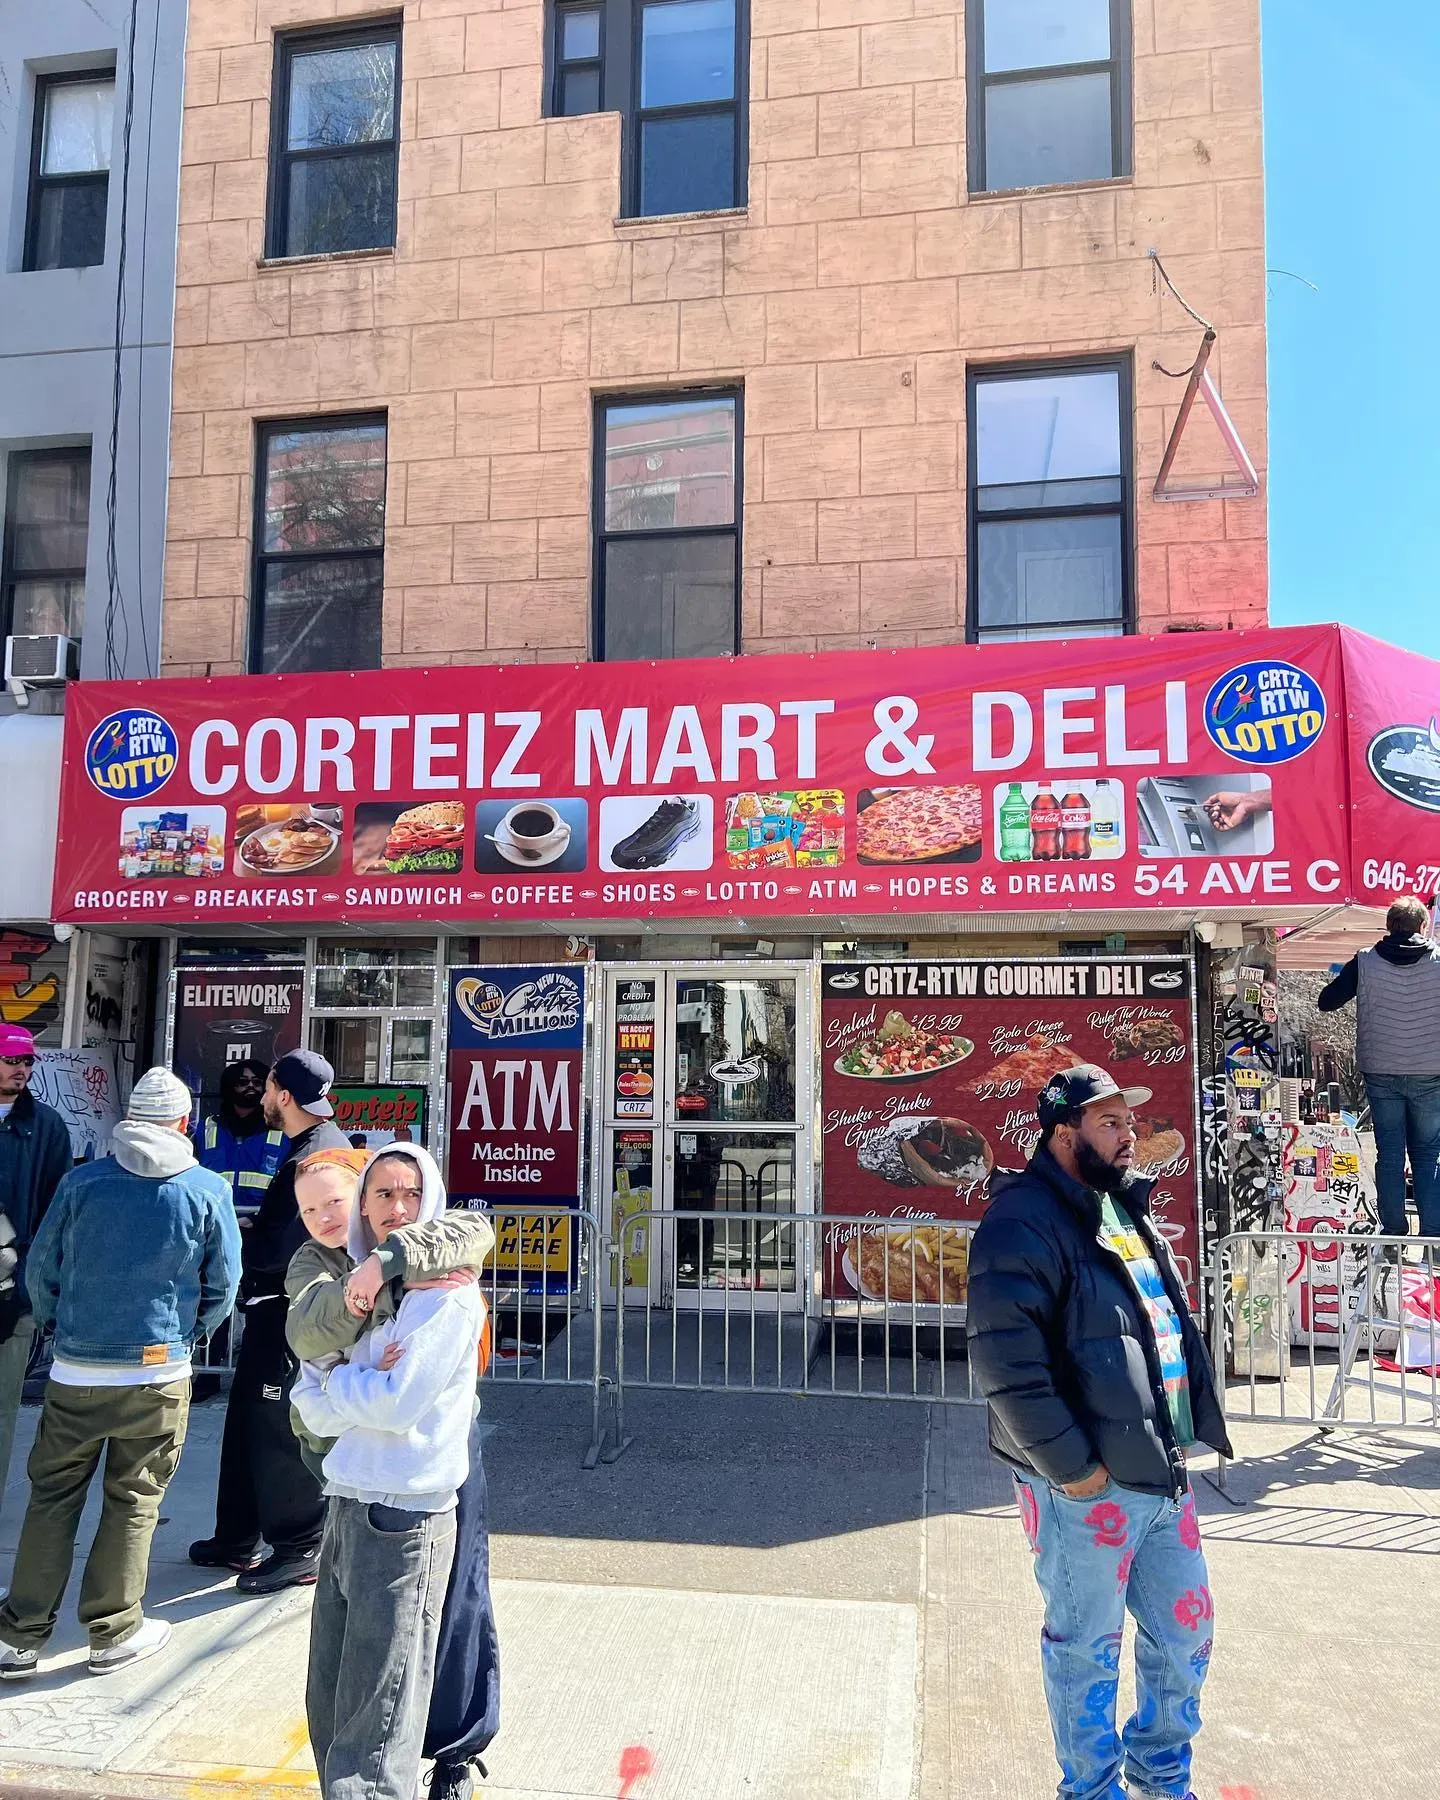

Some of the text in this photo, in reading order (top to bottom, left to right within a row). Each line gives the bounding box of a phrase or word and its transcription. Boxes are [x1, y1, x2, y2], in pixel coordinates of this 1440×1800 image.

[1258, 669, 1302, 690] CRTZ
[1260, 689, 1309, 716] RTW
[128, 717, 162, 736] CRTZ
[189, 681, 1189, 795] CORTEIZ MART & DELI
[1215, 711, 1322, 752] LOTTO
[128, 732, 166, 757] RTW
[93, 753, 174, 790] LOTTO
[1134, 859, 1341, 896] 54 AVE C
[74, 872, 1116, 908] GROCERY BREAKFAST SANDWICH COFFEE SHOES LOTTO ATM HOPES & DREAMS
[536, 973, 579, 992] NEW YORK'S
[865, 965, 1143, 996] CRTZ-RTW GOURMET DELI
[184, 984, 291, 1006] ELITEWORK
[477, 997, 502, 1011] LOTTO
[622, 992, 651, 1000] CREDIT?
[264, 1006, 290, 1014] ENERGY
[1087, 1005, 1174, 1030] Rules The World
[489, 1014, 578, 1039] MILLIONS
[826, 1003, 876, 1048] Salad
[911, 1014, 963, 1031] $13.99
[988, 1020, 1064, 1045] Bolo Cheese
[1103, 1020, 1133, 1039] Cookie
[621, 1033, 650, 1047] RTW
[990, 1030, 1073, 1058] Pizza Slice
[1143, 1045, 1186, 1066] $2.99
[456, 1058, 573, 1133] ATM
[975, 1078, 1023, 1101] $2.99
[623, 1103, 646, 1112] CRTZ
[823, 1092, 933, 1134] Shuku-Shuku
[844, 1122, 886, 1148] Gyro
[472, 1142, 555, 1161] Machine
[484, 1164, 542, 1183] Inside
[500, 1216, 562, 1234] PLAY
[826, 1222, 858, 1252] Fish
[500, 1237, 562, 1255] HERE
